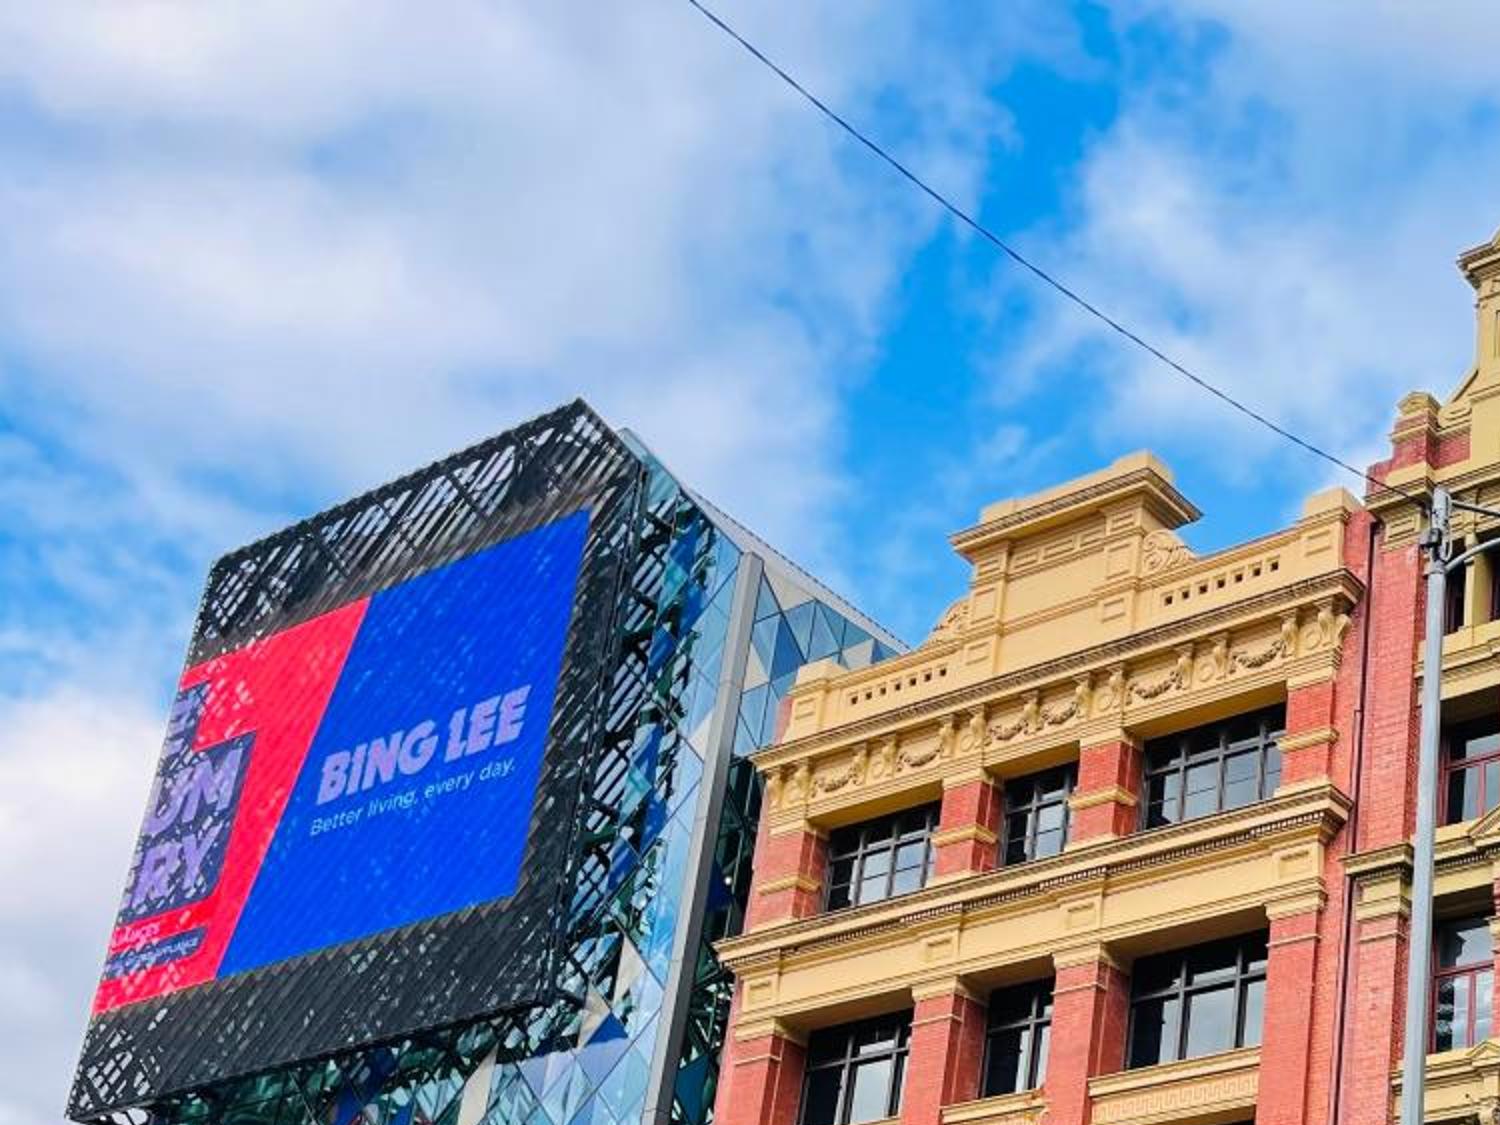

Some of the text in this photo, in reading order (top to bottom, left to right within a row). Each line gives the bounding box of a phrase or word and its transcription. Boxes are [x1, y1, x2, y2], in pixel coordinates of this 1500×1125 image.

[316, 684, 531, 805] BING LEE
[310, 807, 363, 836] Better
[424, 769, 475, 800] every
